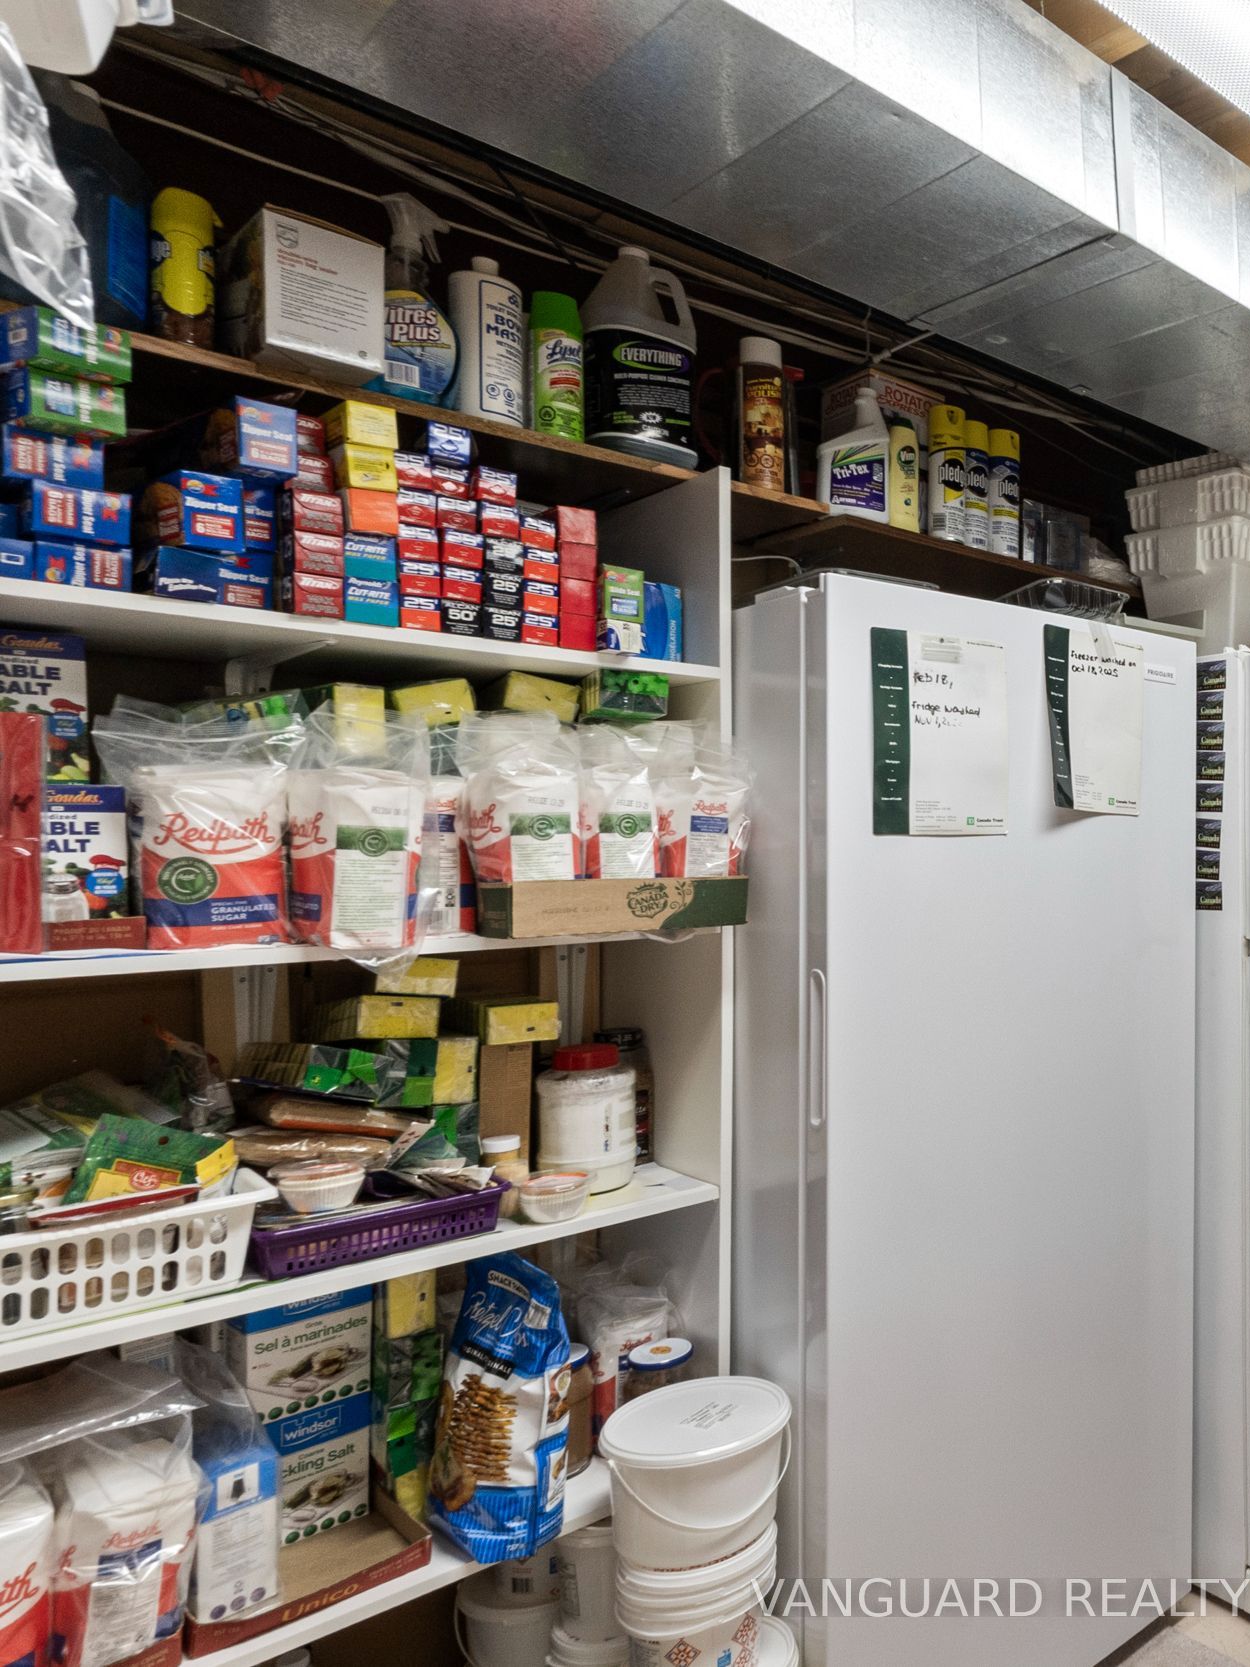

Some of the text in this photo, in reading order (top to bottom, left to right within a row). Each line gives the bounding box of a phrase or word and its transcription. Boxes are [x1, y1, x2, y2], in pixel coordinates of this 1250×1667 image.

[392, 324, 440, 343] Plus
[621, 347, 684, 368] EVERYTHING
[884, 386, 933, 412] ROTATO
[53, 460, 68, 481] Seal
[833, 463, 870, 480] Tri-Tex
[938, 465, 966, 489] pledg
[81, 490, 96, 534] Zipper Seal
[185, 496, 239, 515] Zipper Seal
[195, 522, 205, 534] 6
[448, 609, 477, 622] 50'
[0, 667, 61, 681] ABLE
[46, 821, 101, 836] BLE
[153, 811, 276, 852] Redpath
[43, 838, 91, 853] ALT
[211, 903, 275, 915] GRANULATED
[627, 891, 669, 911] CANADA
[639, 902, 663, 914] DRY
[211, 912, 248, 922] SUGAR
[254, 1315, 369, 1355] Sel à marinades
[284, 1415, 339, 1442] windsor
[281, 1442, 356, 1480] ckling Salt
[281, 1582, 361, 1623] Unico
